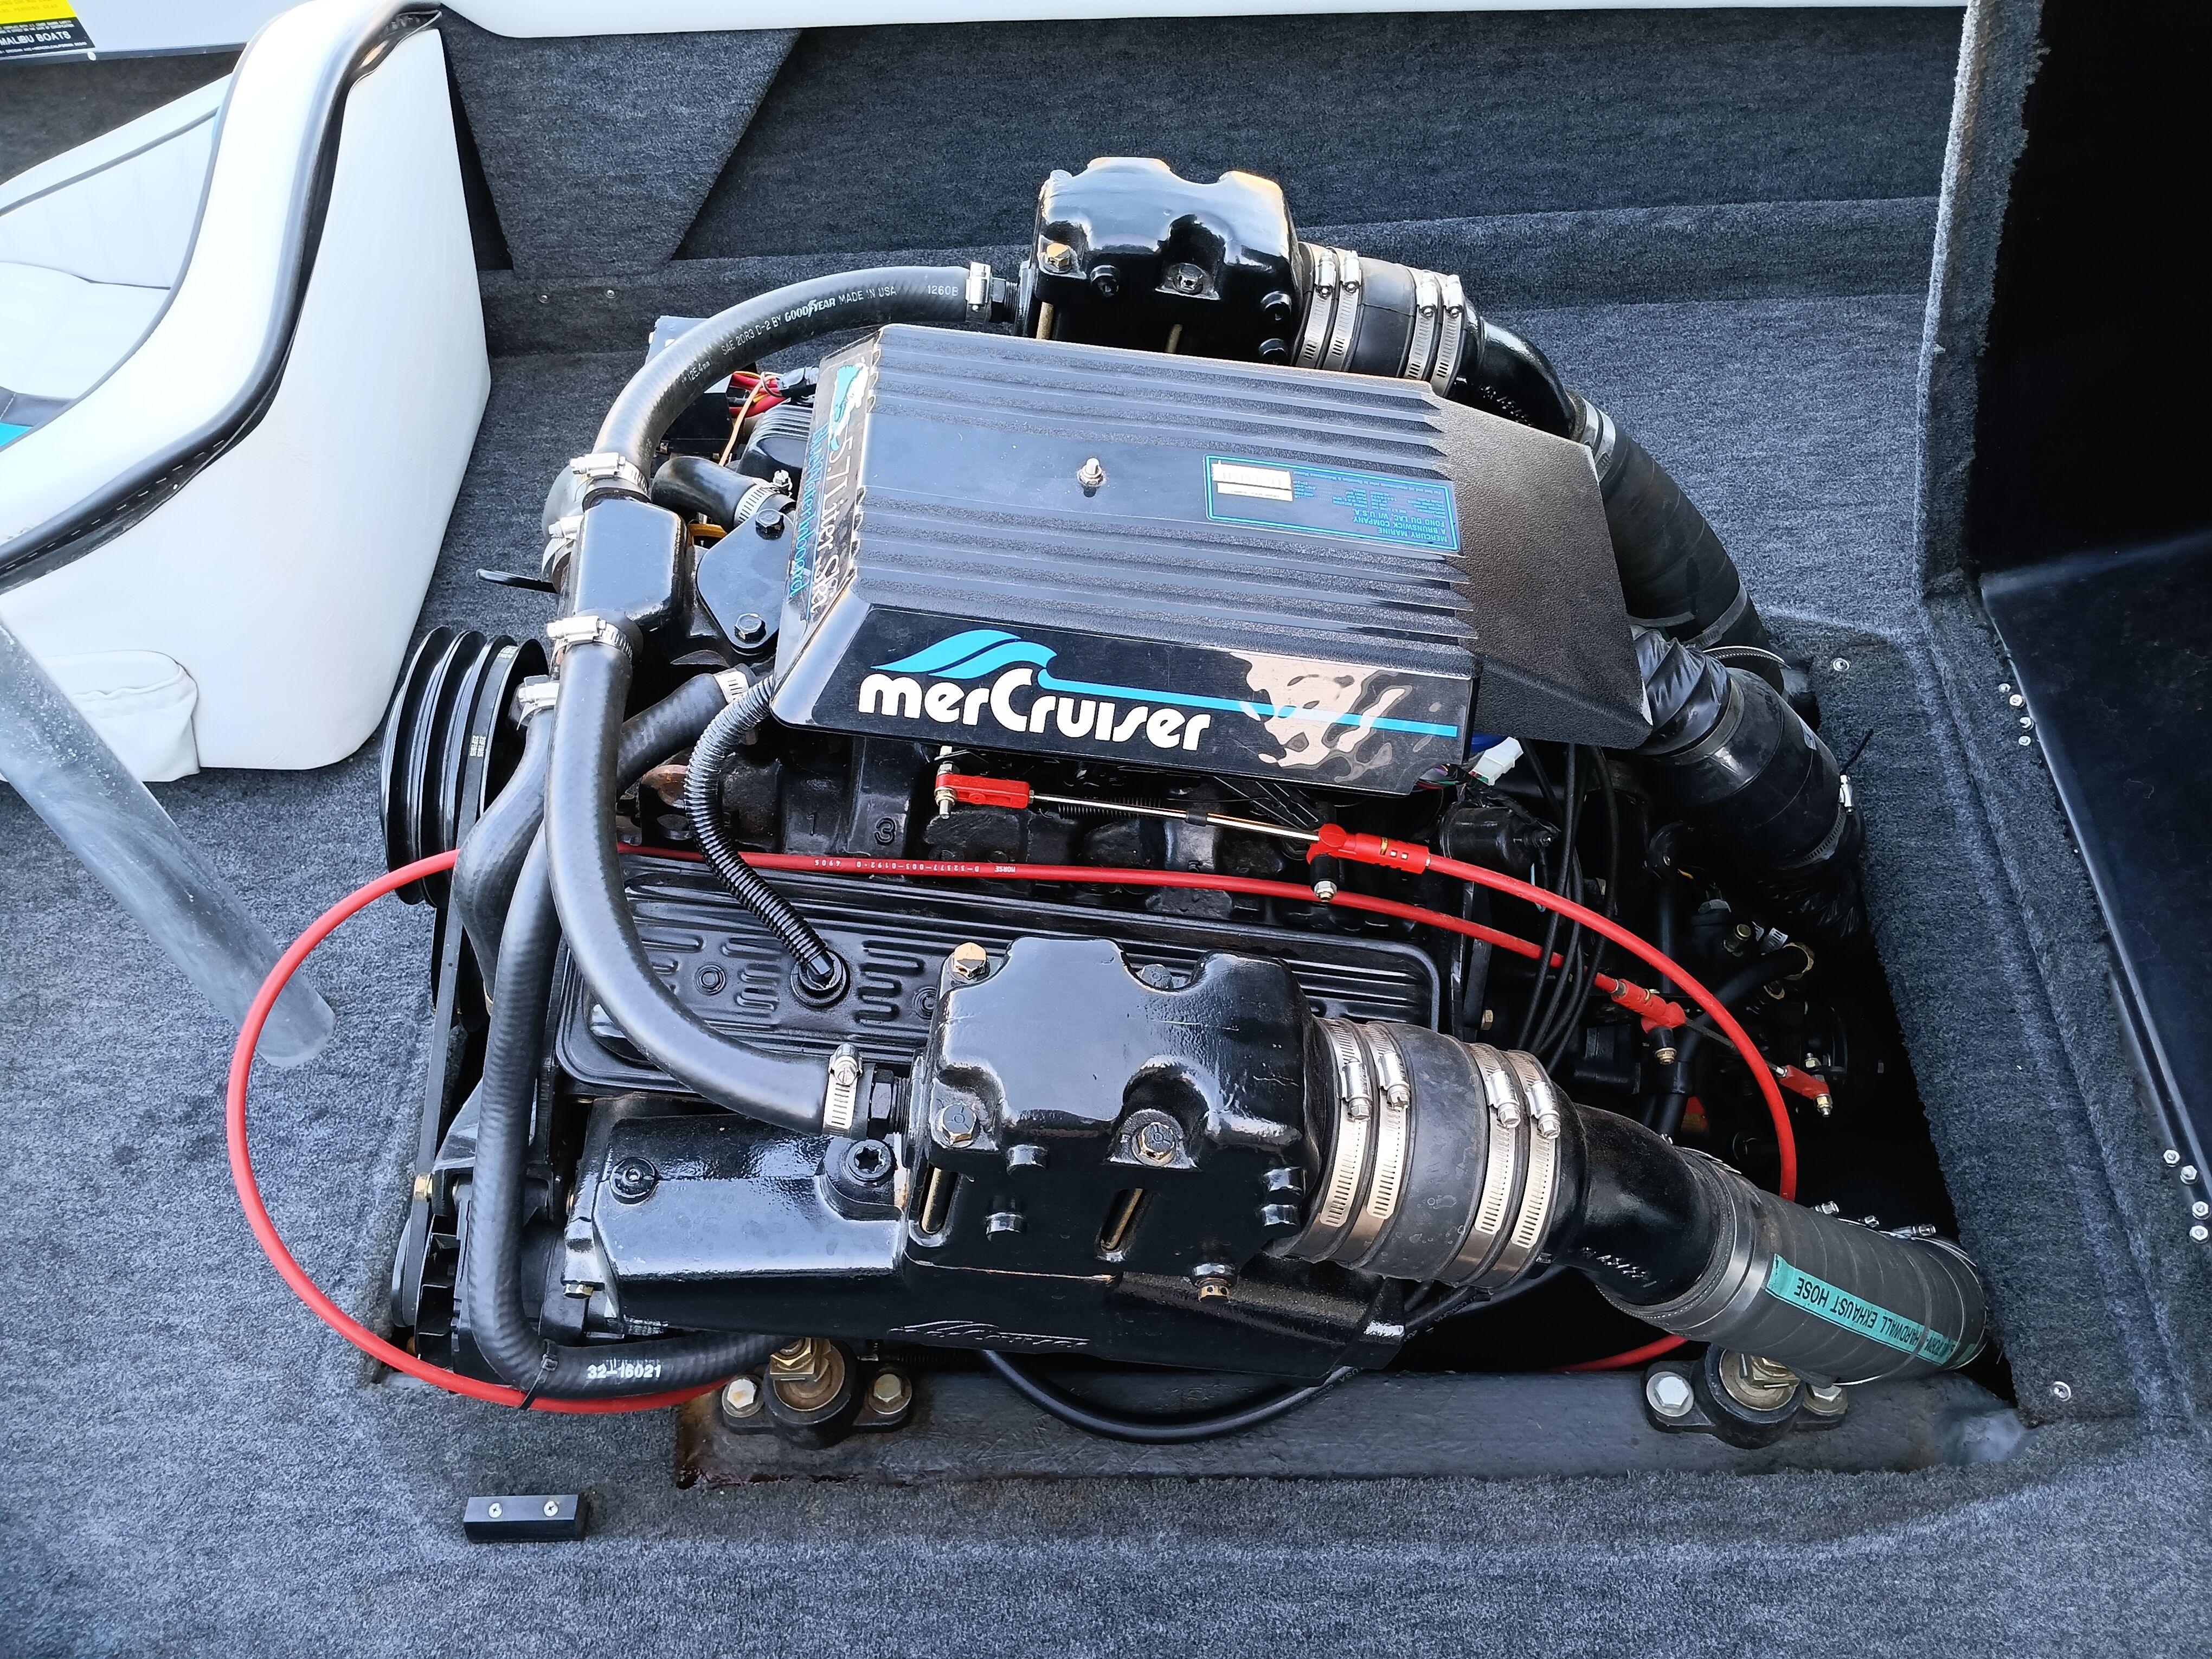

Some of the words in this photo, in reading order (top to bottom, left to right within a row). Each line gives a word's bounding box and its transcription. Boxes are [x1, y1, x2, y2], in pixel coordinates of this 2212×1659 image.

[0, 35, 35, 46] MALIBU
[35, 31, 71, 42] BOATS
[721, 340, 736, 356] SAE
[736, 329, 755, 346] 20R3
[755, 320, 771, 335] D-2
[771, 314, 782, 327] BY
[784, 298, 836, 322] GOODYEAR
[839, 290, 864, 305] MADE
[866, 288, 876, 300] IN
[878, 286, 897, 298] USA
[927, 285, 959, 297] 1260B
[826, 435, 853, 481] 5.7
[817, 476, 847, 551] Liter
[1352, 508, 1375, 518] U.S.A.
[1391, 513, 1409, 522] LAC,
[1353, 516, 1390, 527] COMPANY
[1393, 521, 1437, 533] BRUNSWICK
[1425, 519, 1445, 528] FOND
[1378, 526, 1408, 537] MARINE
[1411, 531, 1448, 543] MERCURY
[810, 554, 840, 614] Ski
[858, 667, 1211, 751] merCruiser
[874, 816, 897, 846] 3
[1793, 1277, 1830, 1308] HOSE
[1830, 1295, 1879, 1329] EXHAUST
[1880, 1316, 1922, 1346] HARDWALL
[587, 1362, 661, 1379] 32-16021
